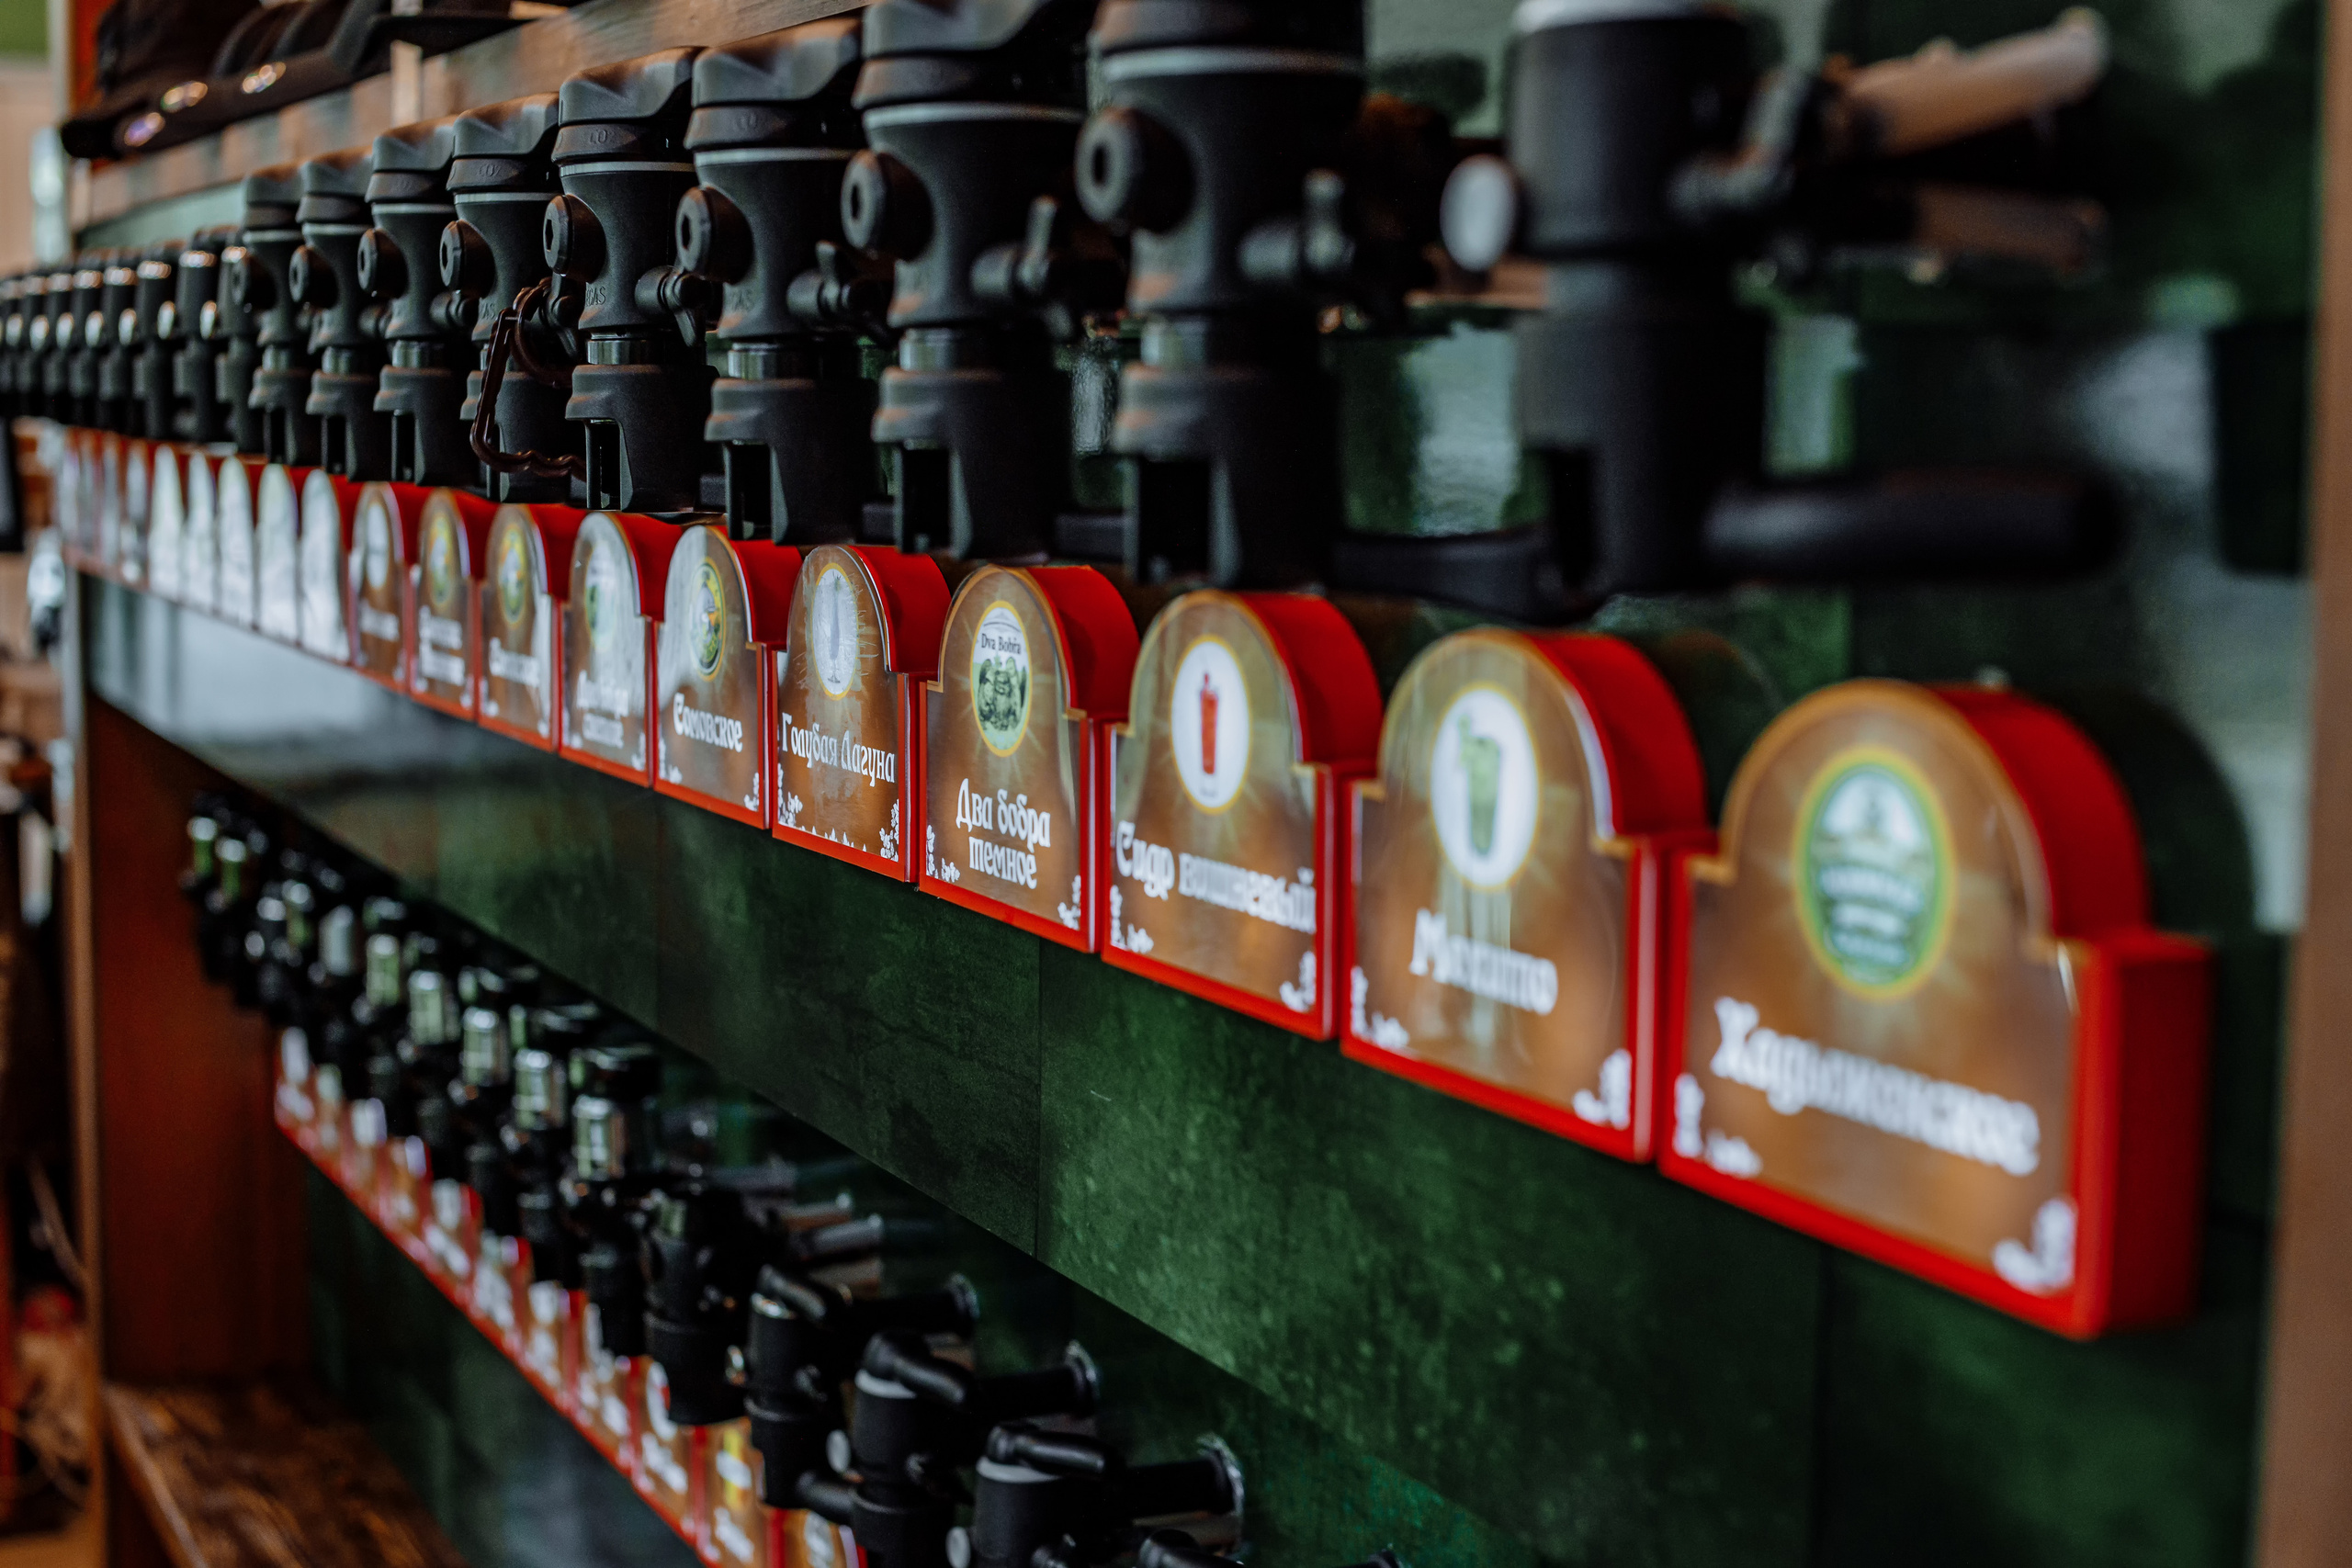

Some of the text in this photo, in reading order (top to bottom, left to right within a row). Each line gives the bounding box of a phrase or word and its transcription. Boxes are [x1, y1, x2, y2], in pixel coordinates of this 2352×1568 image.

[981, 634, 996, 650] Dva
[782, 712, 895, 787] Голубая Лагуна
[956, 778, 1050, 853] Два бобра
[968, 836, 1037, 890] темное
[1116, 819, 1175, 901] Сидр
